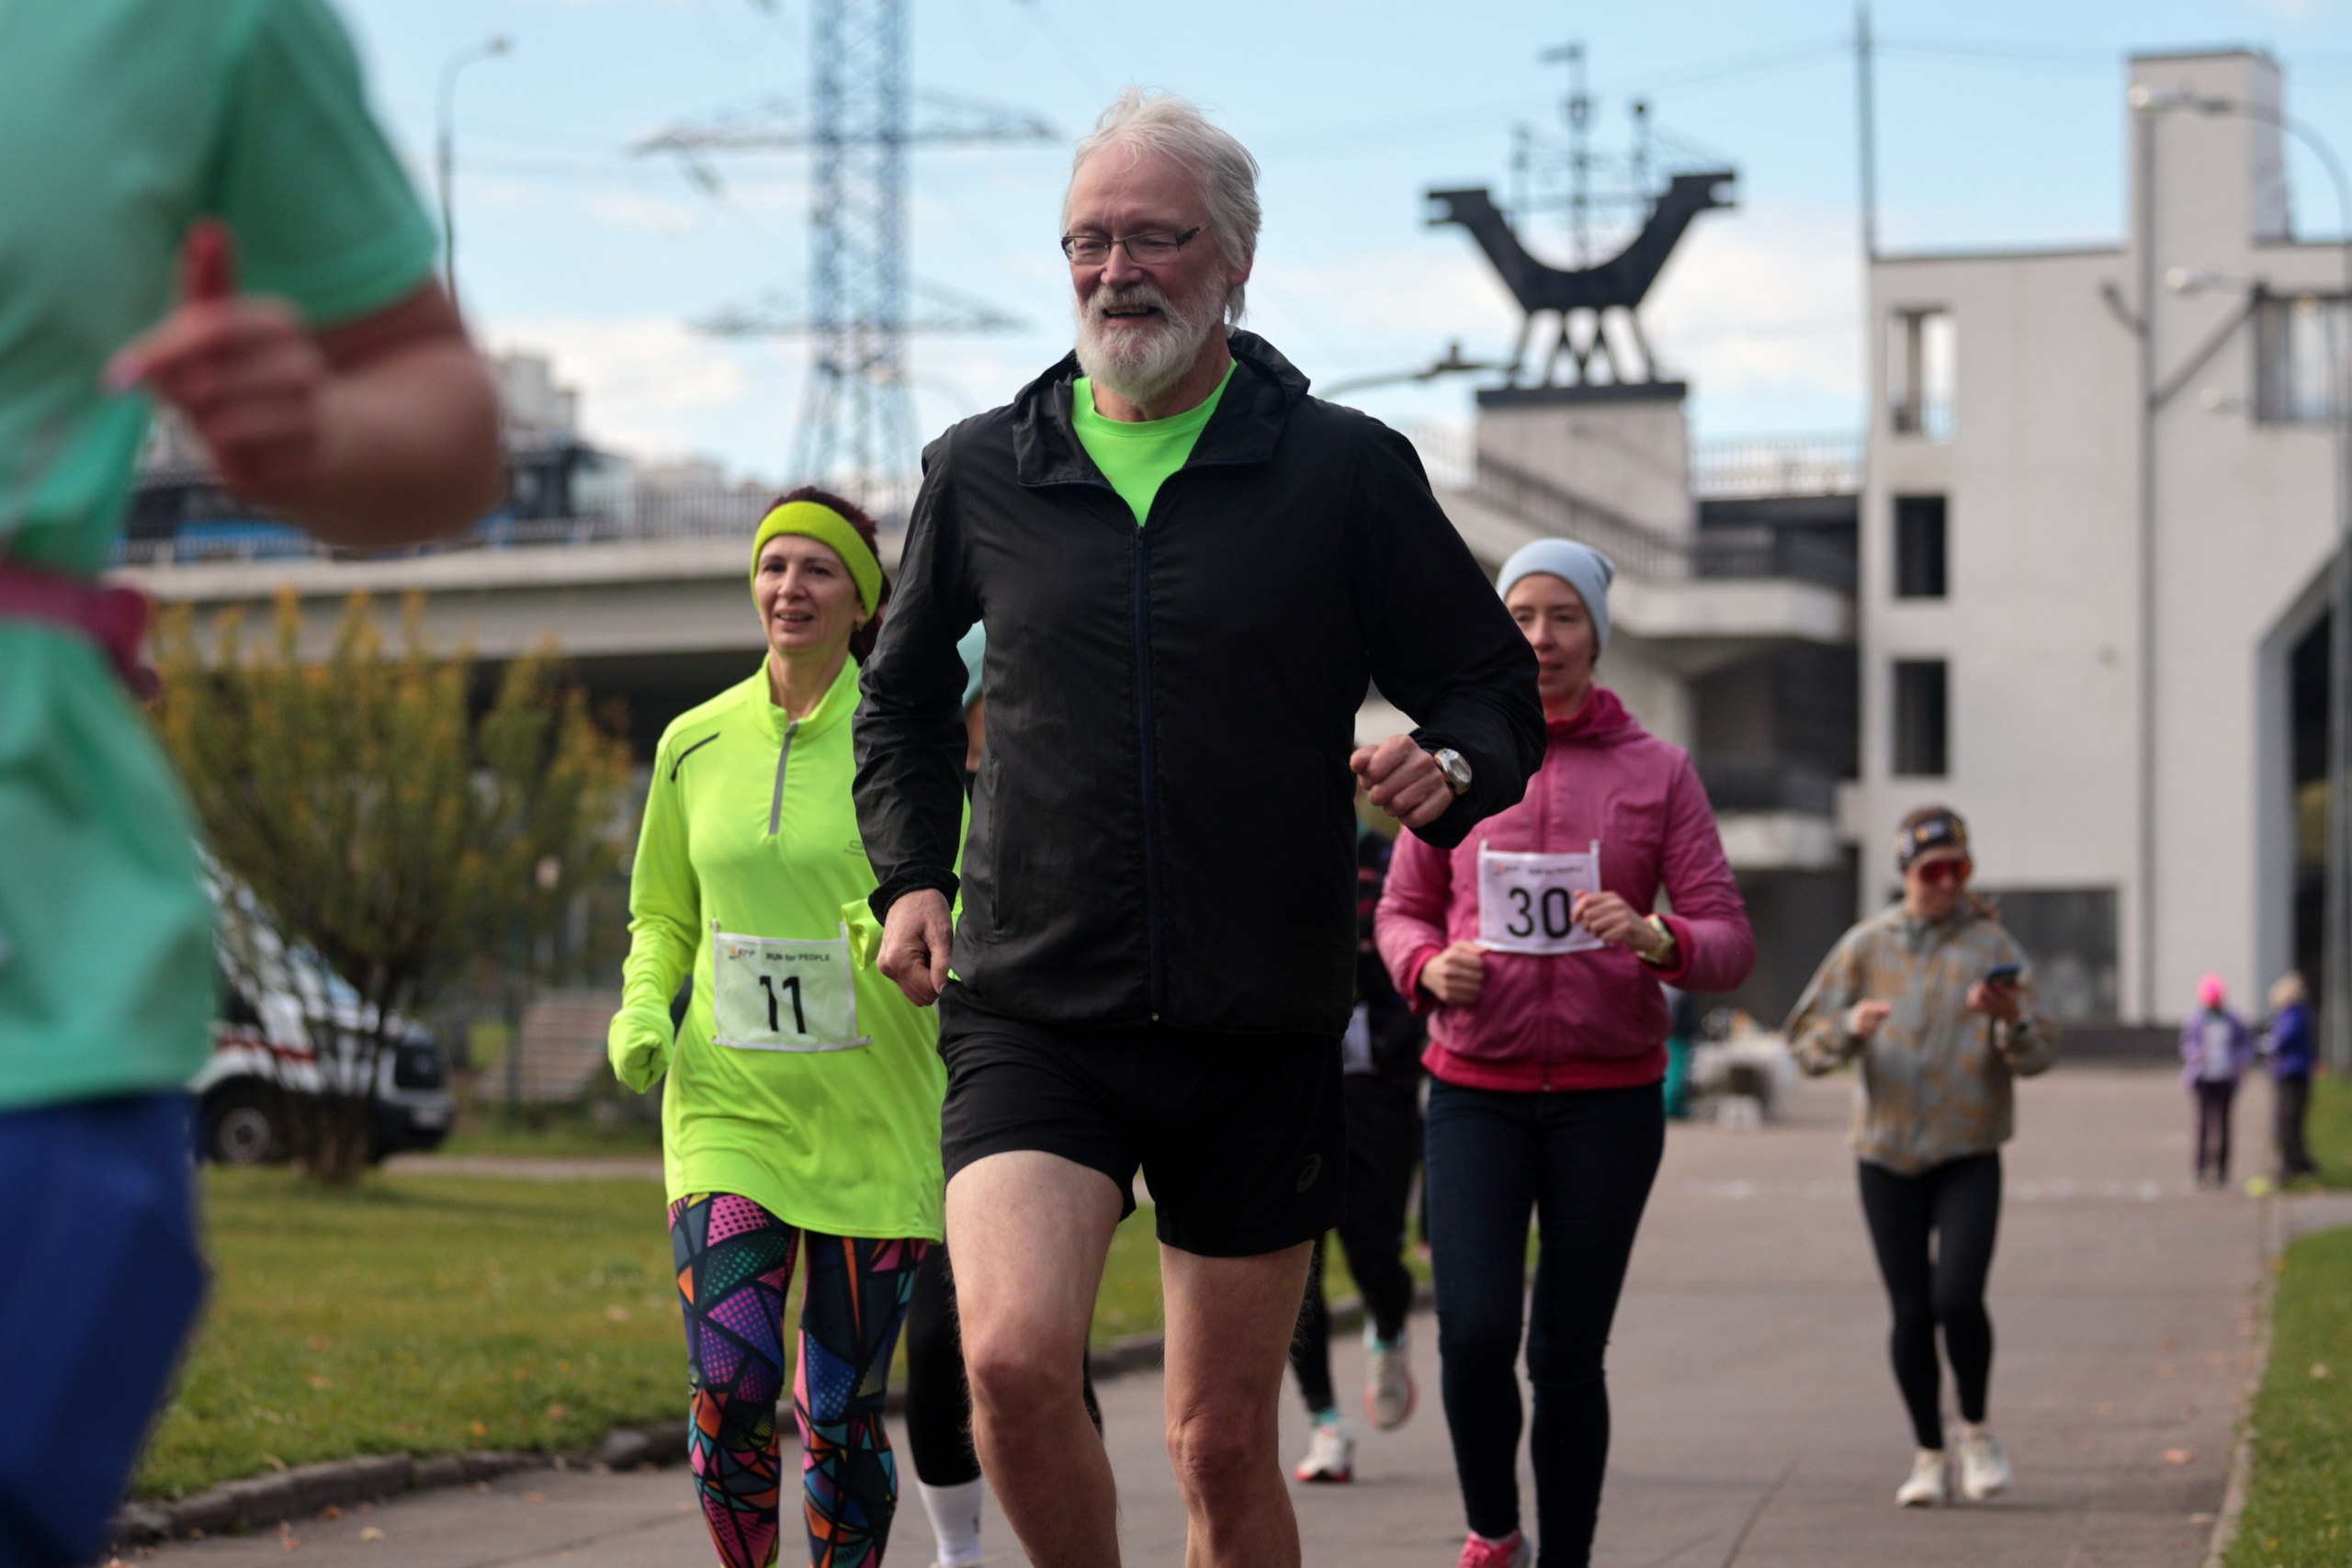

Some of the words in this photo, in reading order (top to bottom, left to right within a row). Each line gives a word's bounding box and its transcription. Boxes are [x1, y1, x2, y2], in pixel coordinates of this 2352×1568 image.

[1508, 886, 1571, 938] 30
[766, 953, 783, 961] RUN
[798, 953, 830, 962] PEOPLE
[760, 976, 807, 1034] 11
